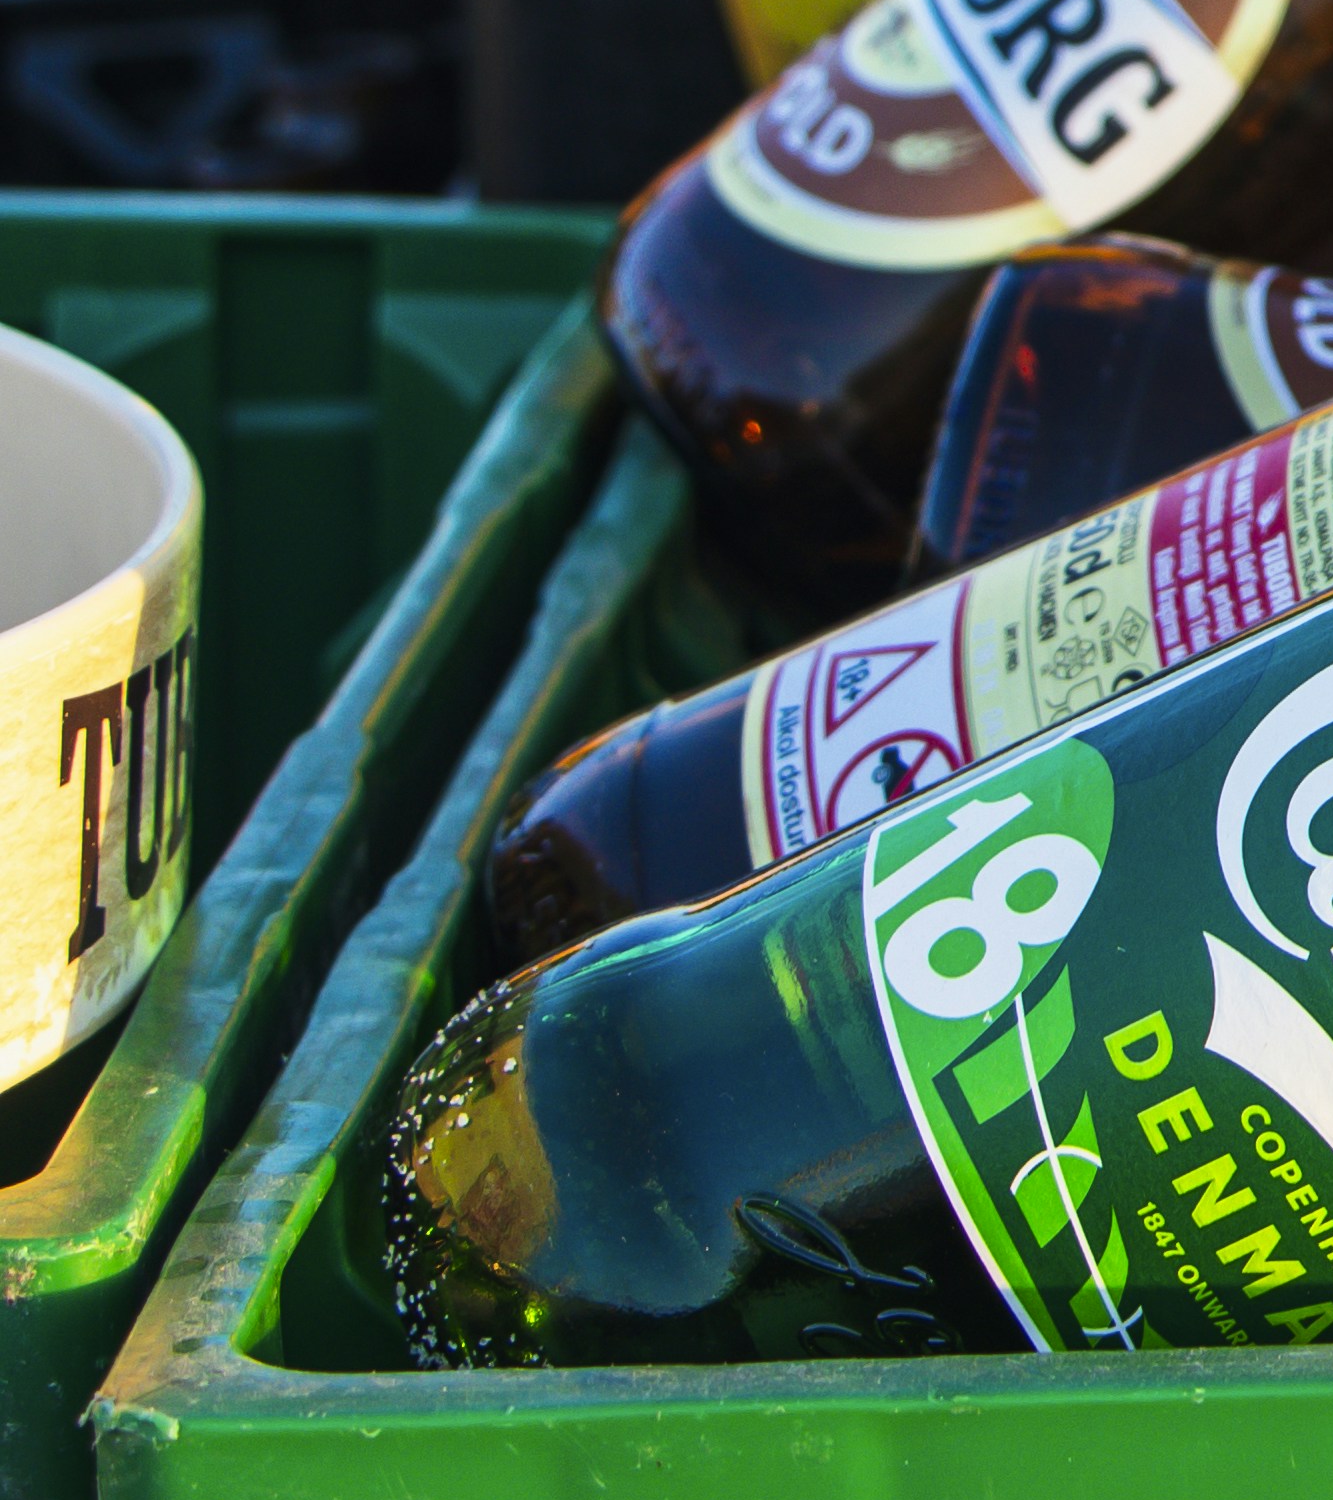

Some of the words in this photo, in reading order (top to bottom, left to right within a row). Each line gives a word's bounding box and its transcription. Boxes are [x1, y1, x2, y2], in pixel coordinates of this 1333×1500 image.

[836, 656, 868, 704] 18+
[778, 704, 799, 759] Alkol
[869, 791, 1101, 1019] 18
[1137, 1202, 1185, 1259] 1847
[1177, 1263, 1254, 1346] ONWAR
